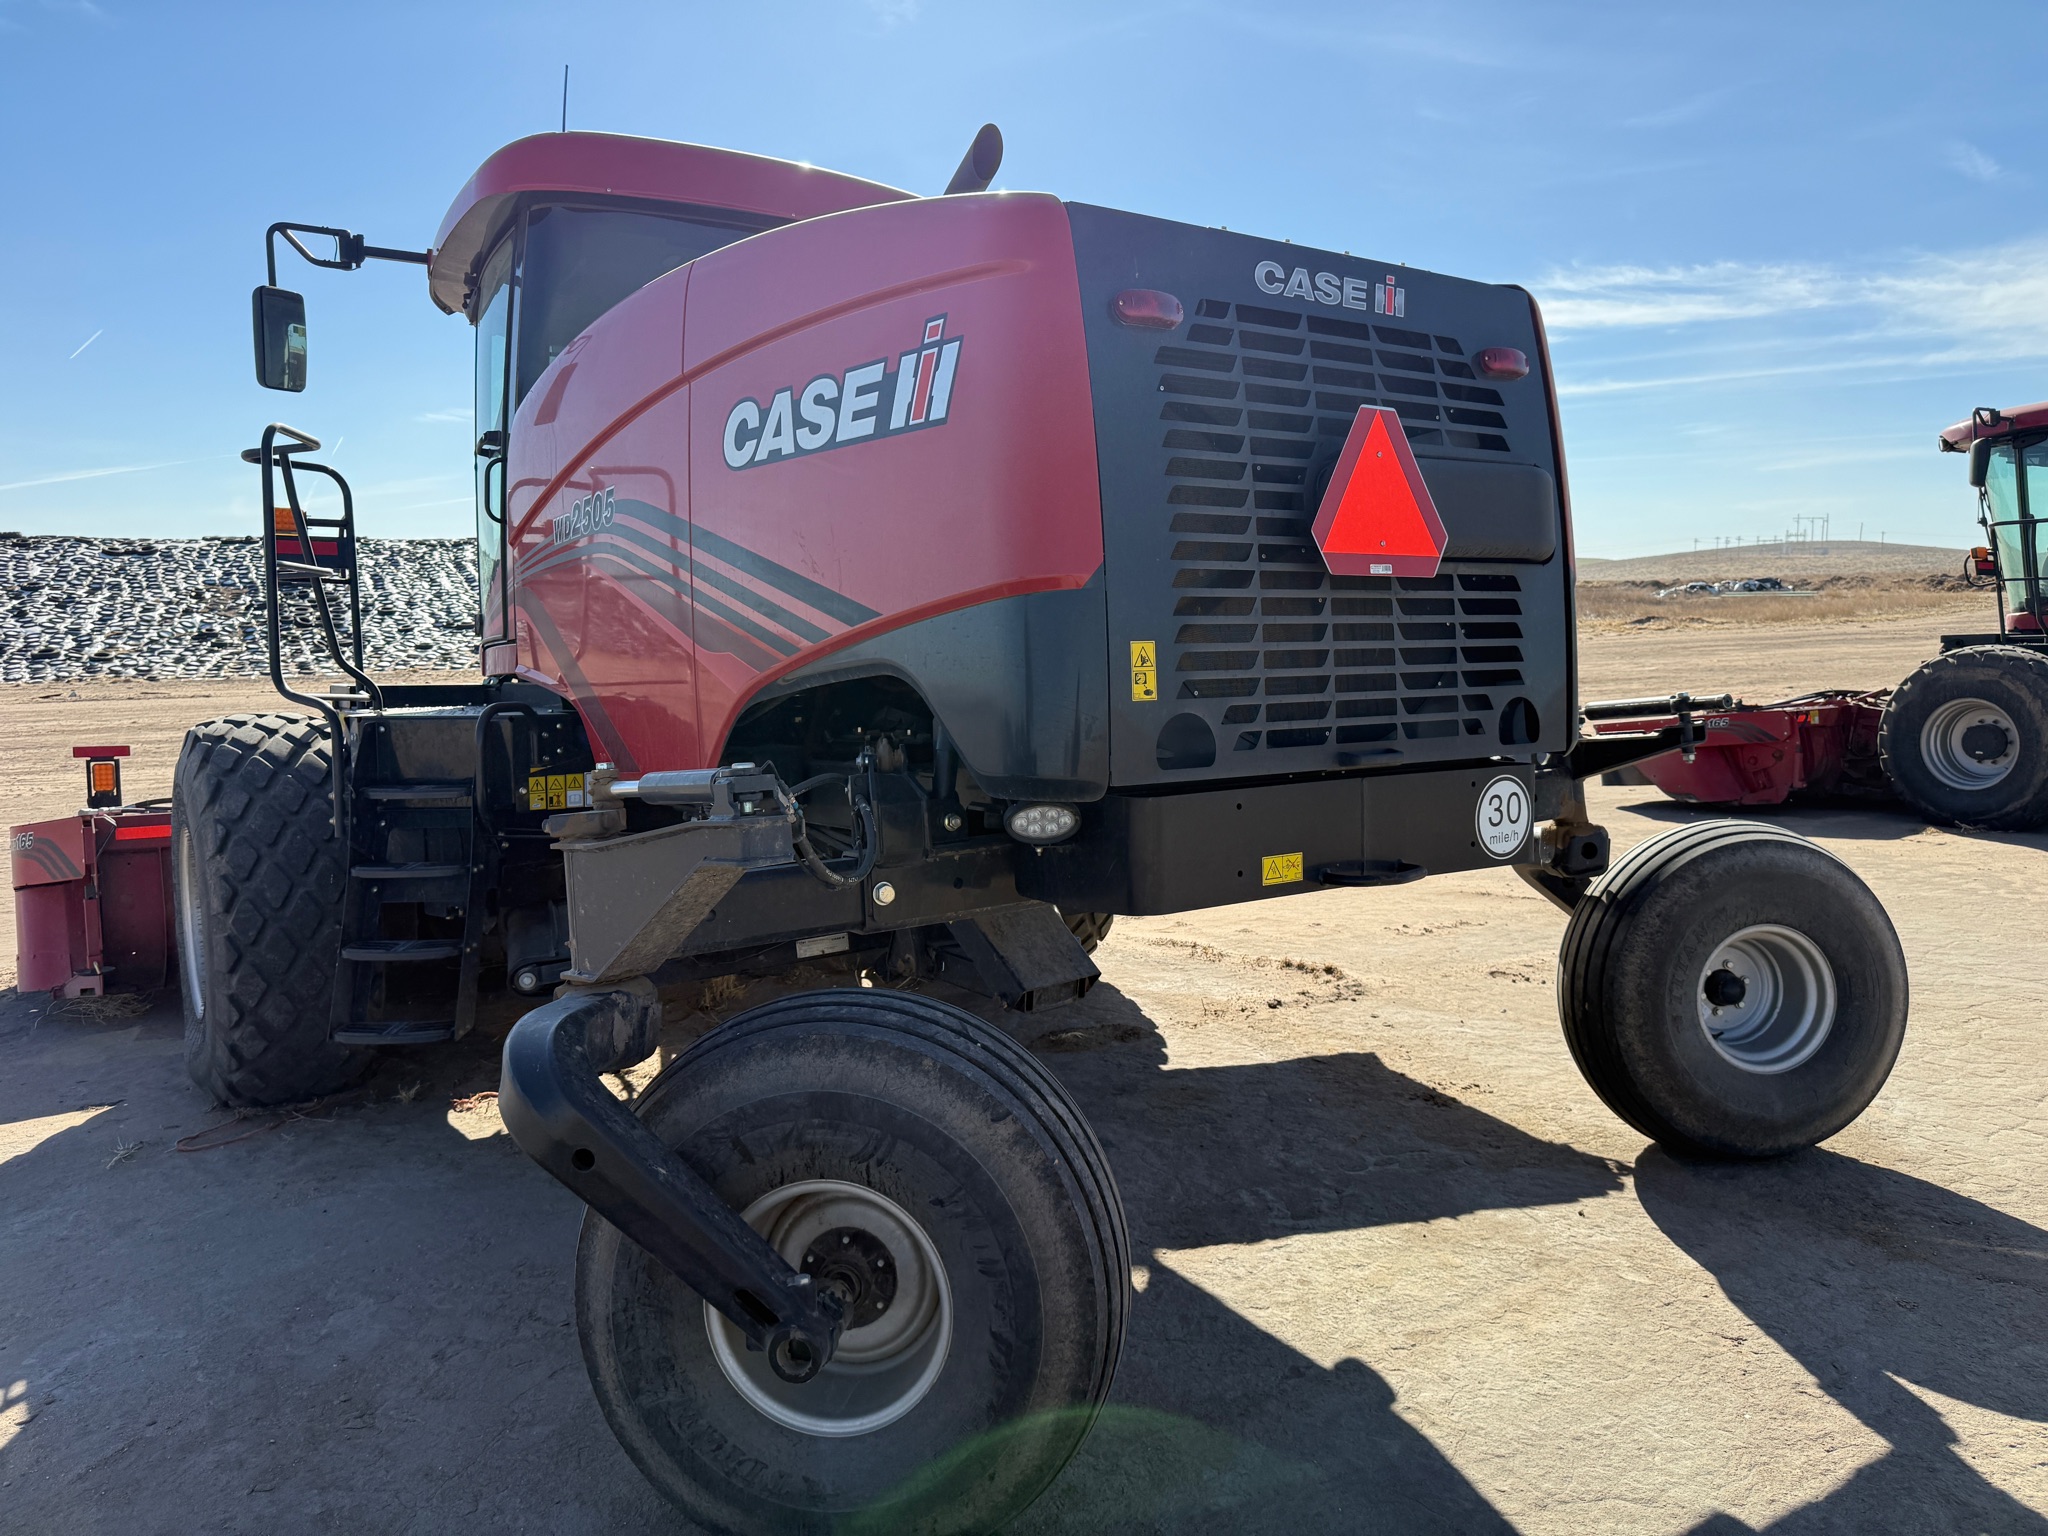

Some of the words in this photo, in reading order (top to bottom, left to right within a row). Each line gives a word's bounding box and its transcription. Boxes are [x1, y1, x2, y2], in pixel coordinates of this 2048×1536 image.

[1254, 260, 1368, 311] CASE
[722, 361, 885, 469] CASE
[553, 485, 615, 545] WD2505
[1488, 791, 1522, 827] 30
[1489, 830, 1519, 845] mile/h
